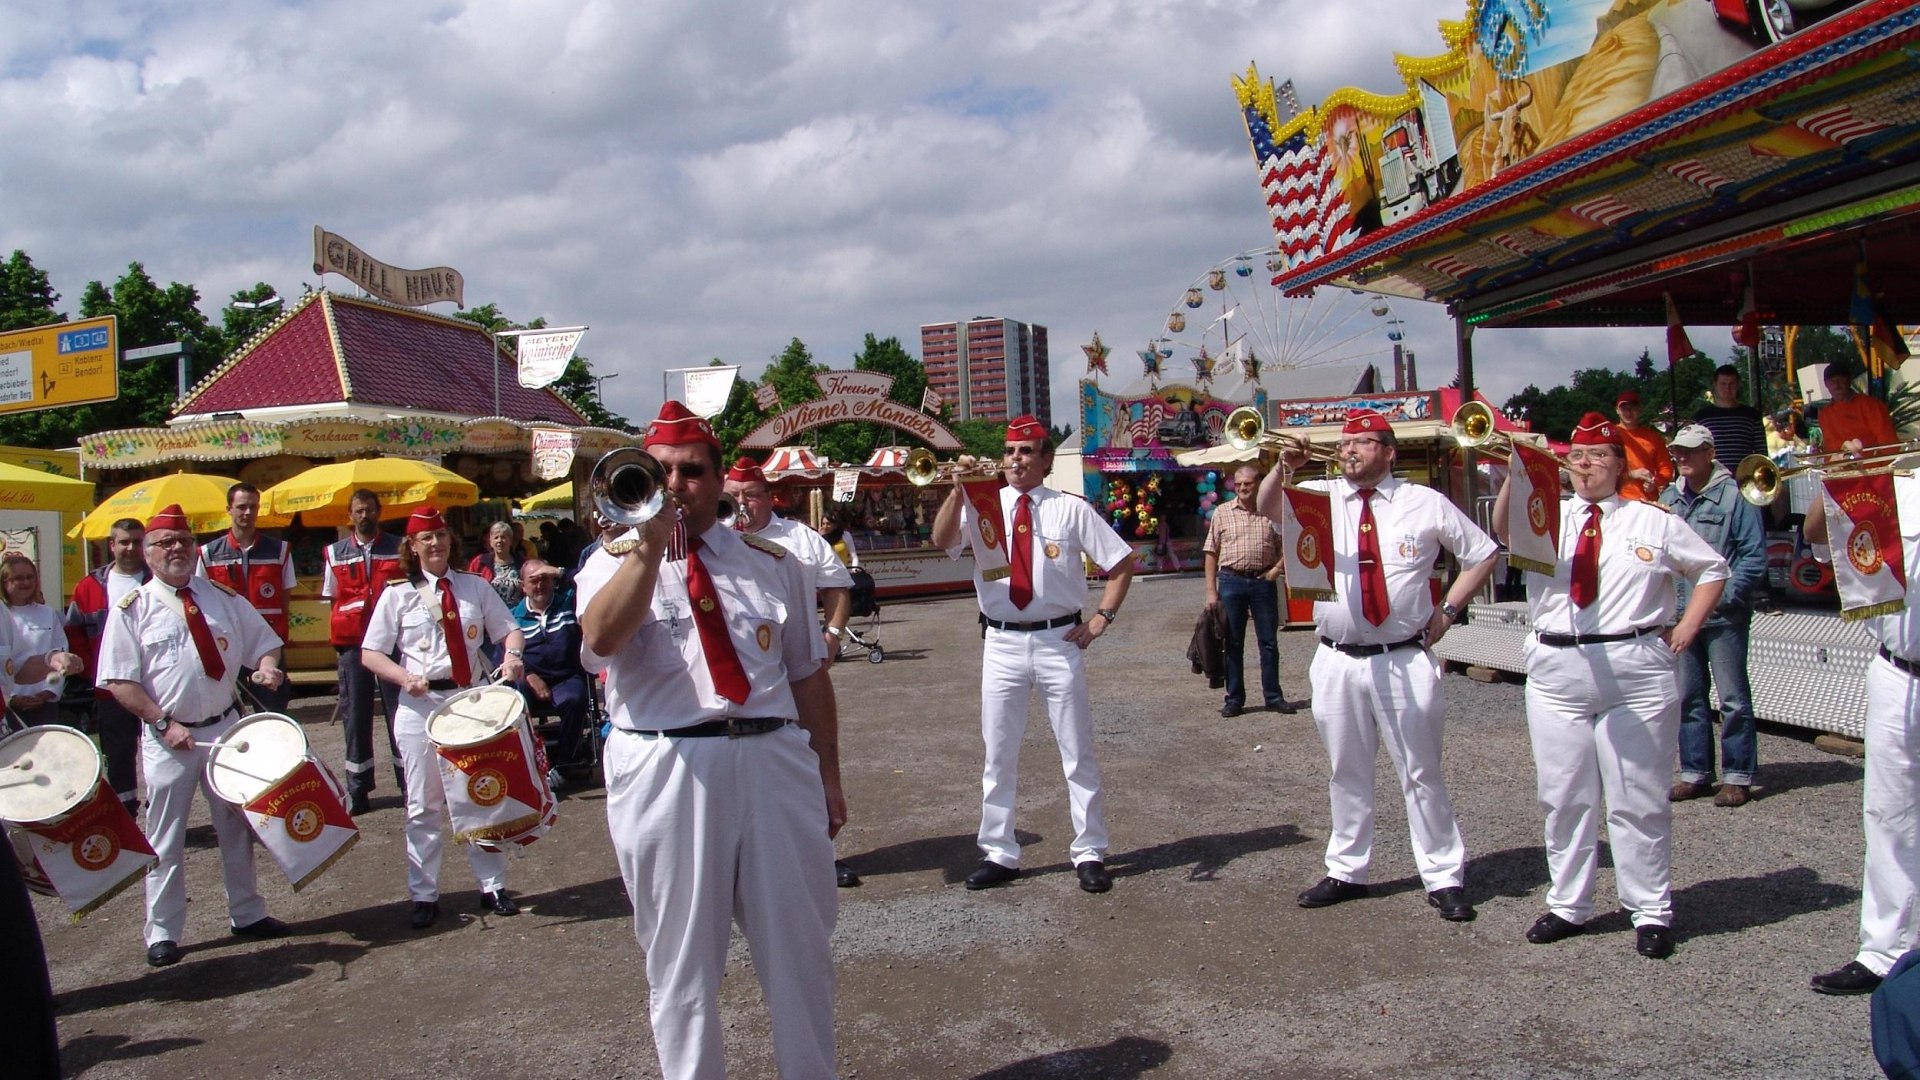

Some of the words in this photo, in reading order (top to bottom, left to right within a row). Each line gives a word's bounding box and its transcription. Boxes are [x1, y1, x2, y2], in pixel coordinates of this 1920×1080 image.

[327, 240, 393, 299] GRILL
[405, 272, 456, 300] HAUS
[74, 354, 103, 365] Koblenz
[75, 366, 102, 377] Bendorf
[824, 375, 888, 398] Kreuser's
[773, 400, 849, 439] Wiener
[853, 399, 936, 439] Mandeln
[302, 428, 360, 443] Krakauer
